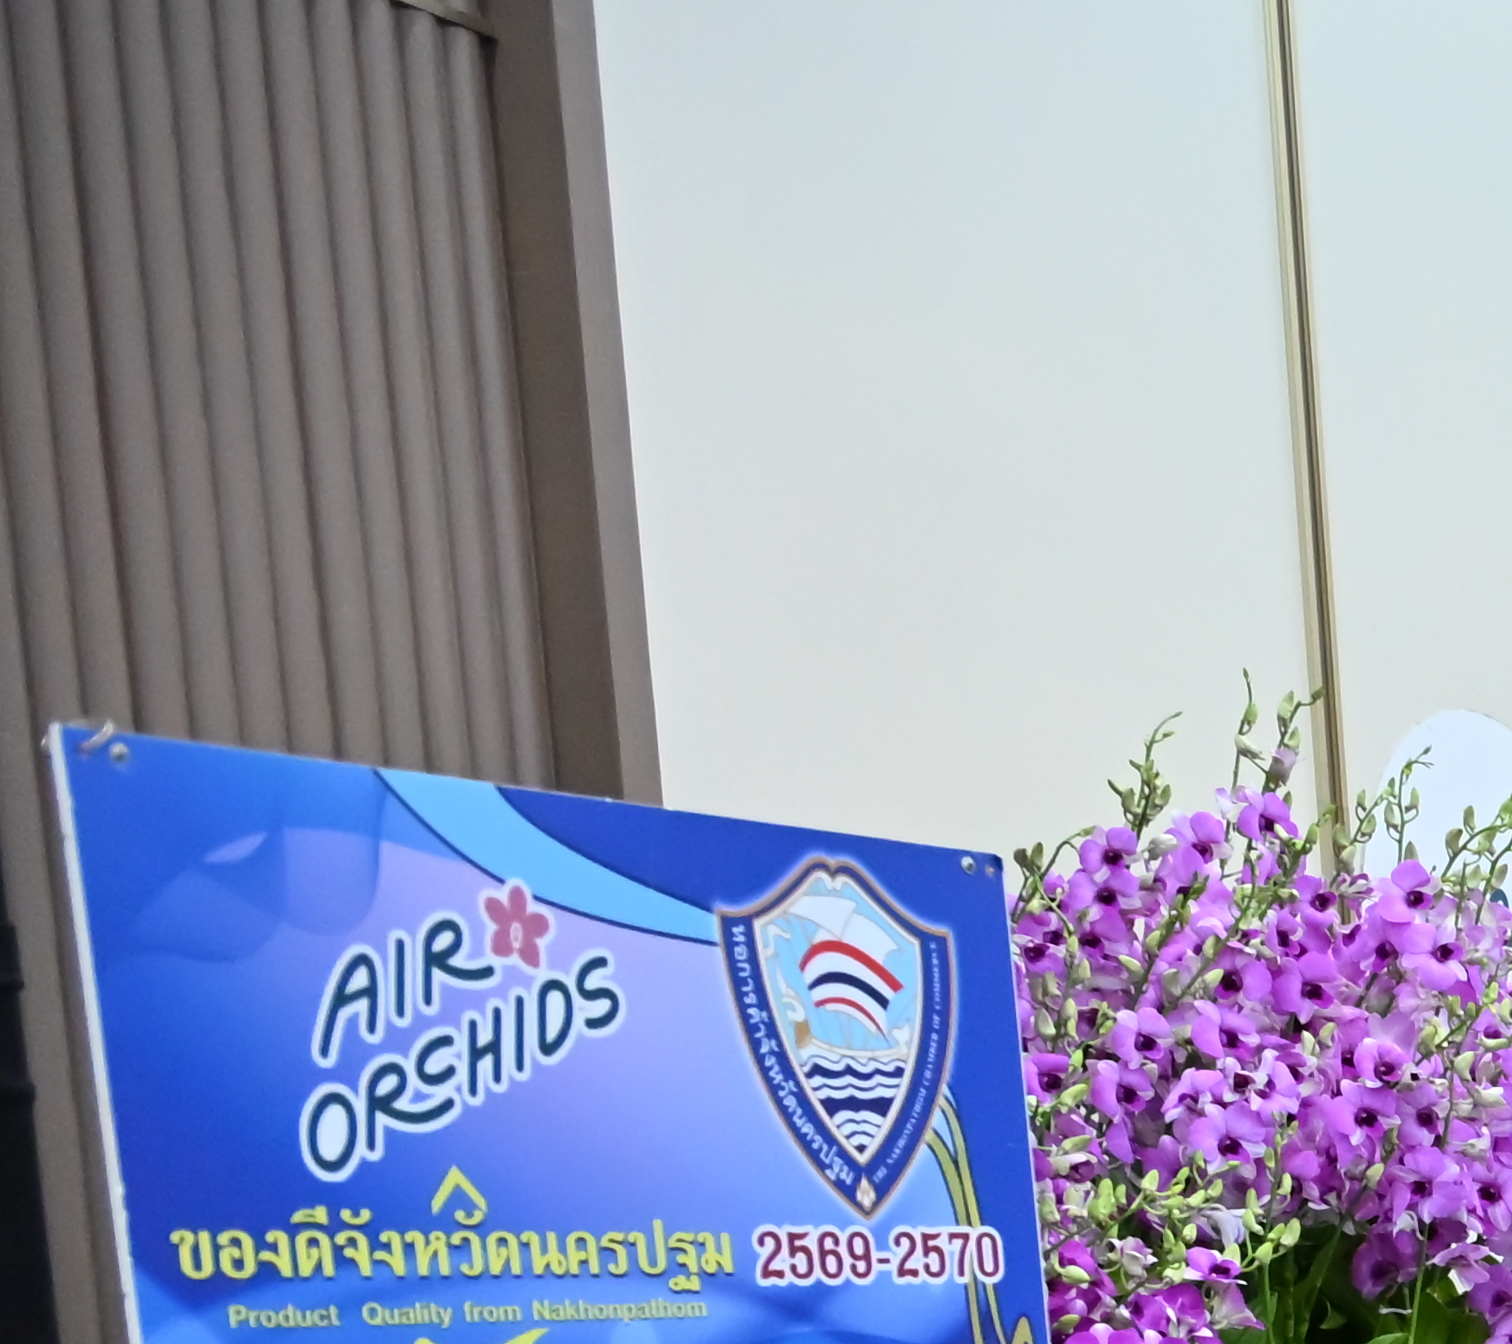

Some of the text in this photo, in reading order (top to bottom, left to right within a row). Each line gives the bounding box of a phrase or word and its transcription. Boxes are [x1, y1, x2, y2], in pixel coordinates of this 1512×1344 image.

[318, 918, 495, 1059] AIR
[307, 955, 620, 1173] ORCHIDS
[170, 1205, 736, 1293] ของดีจังหวัดนครปฐม
[754, 1227, 1003, 1284] 2569-2570
[228, 1297, 708, 1329] Product Quality from Nakhonpathom
